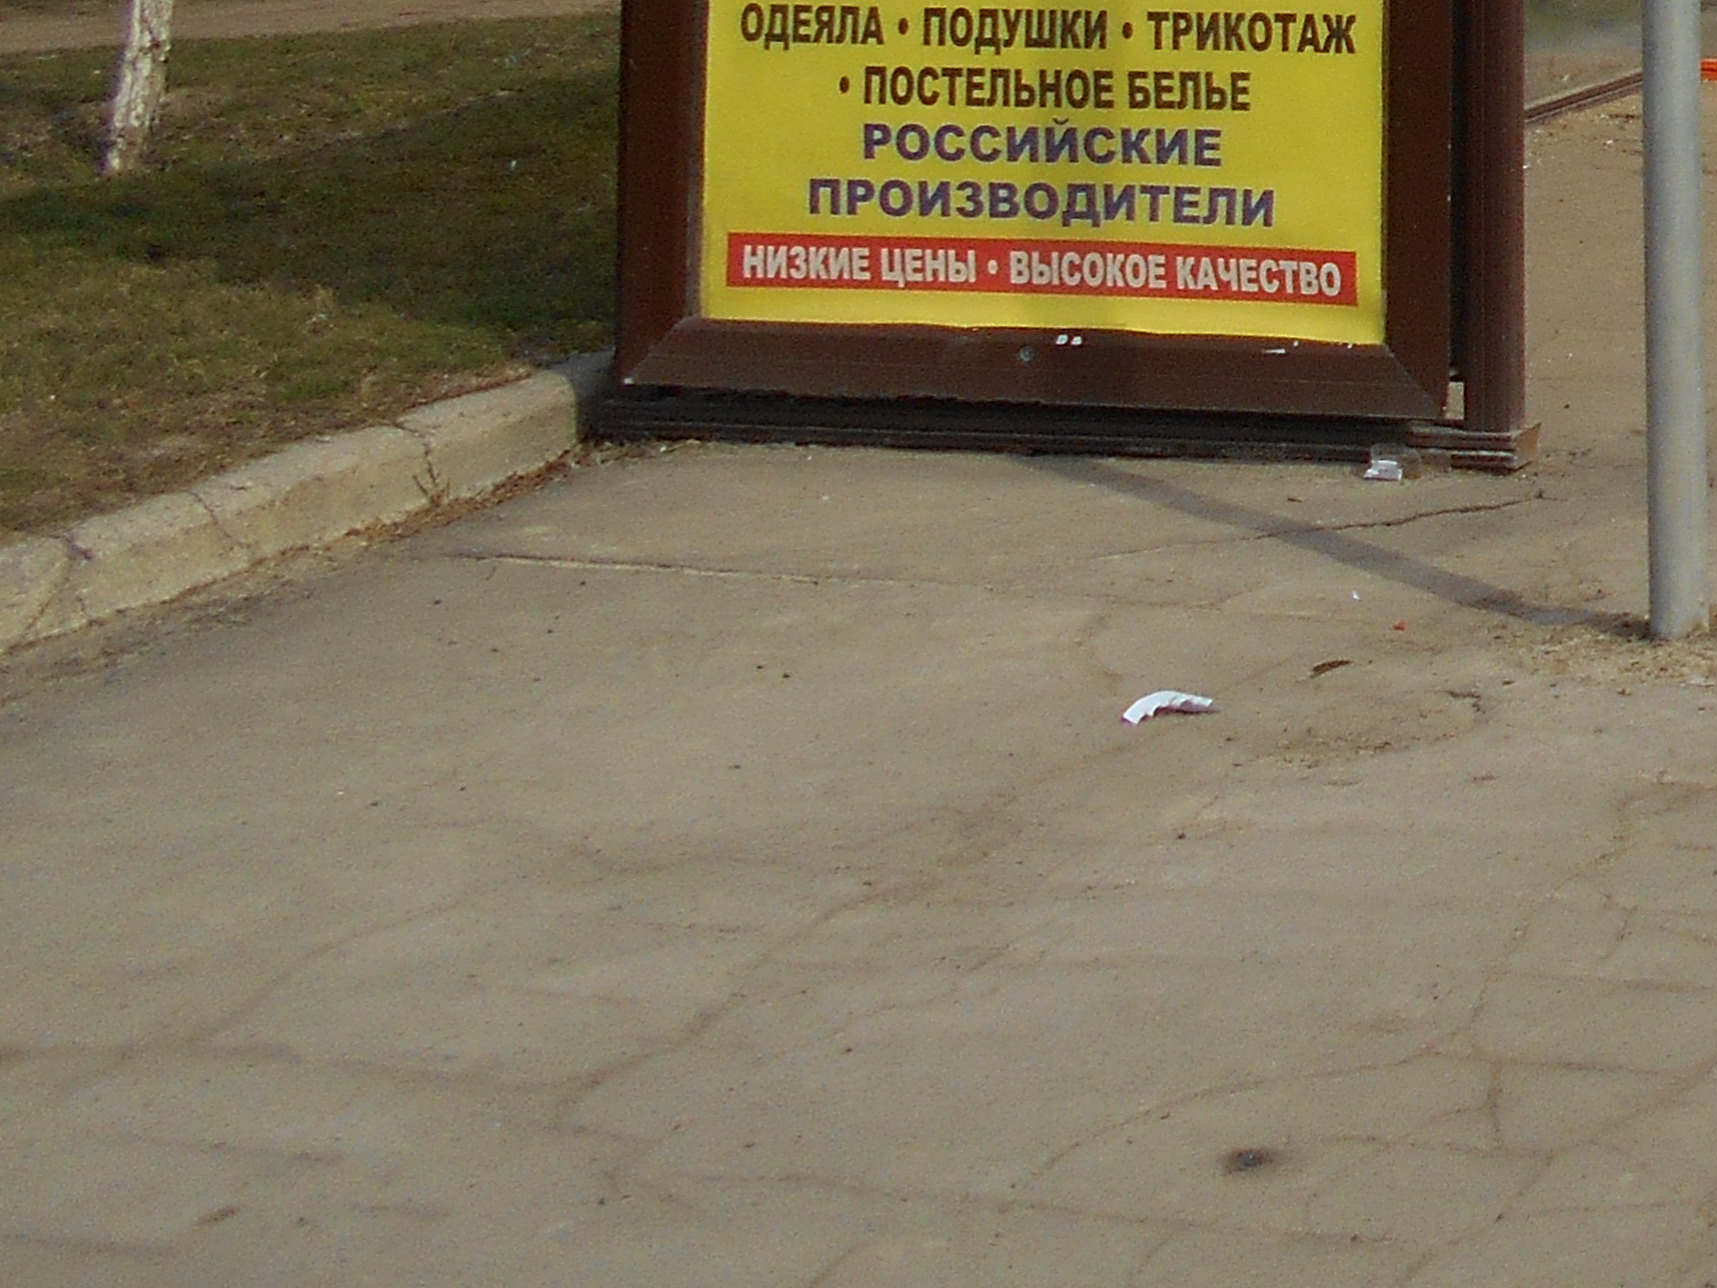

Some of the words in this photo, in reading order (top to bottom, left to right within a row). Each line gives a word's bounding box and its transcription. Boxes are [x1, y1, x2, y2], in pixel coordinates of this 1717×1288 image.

[740, 2, 885, 51] ОДЕЯЛА
[922, 7, 1109, 56] ПОДУШКИ
[1146, 10, 1358, 54] ТРИКОТАЖ
[862, 65, 1115, 109] ПОСТЕЛЬНОЕ
[1127, 70, 1252, 111] БЕЛЬЕ
[862, 117, 1223, 167] РОССИЙСКИЕ
[808, 177, 1275, 228] ПРОИЗВОДИТЕЛИ
[742, 244, 871, 281] НИЗКИЕ
[880, 247, 977, 288] ЦЕНЫ
[1008, 249, 1168, 289] ВЫСОКОЕ
[1175, 255, 1342, 297] КАЧЕСТВО
